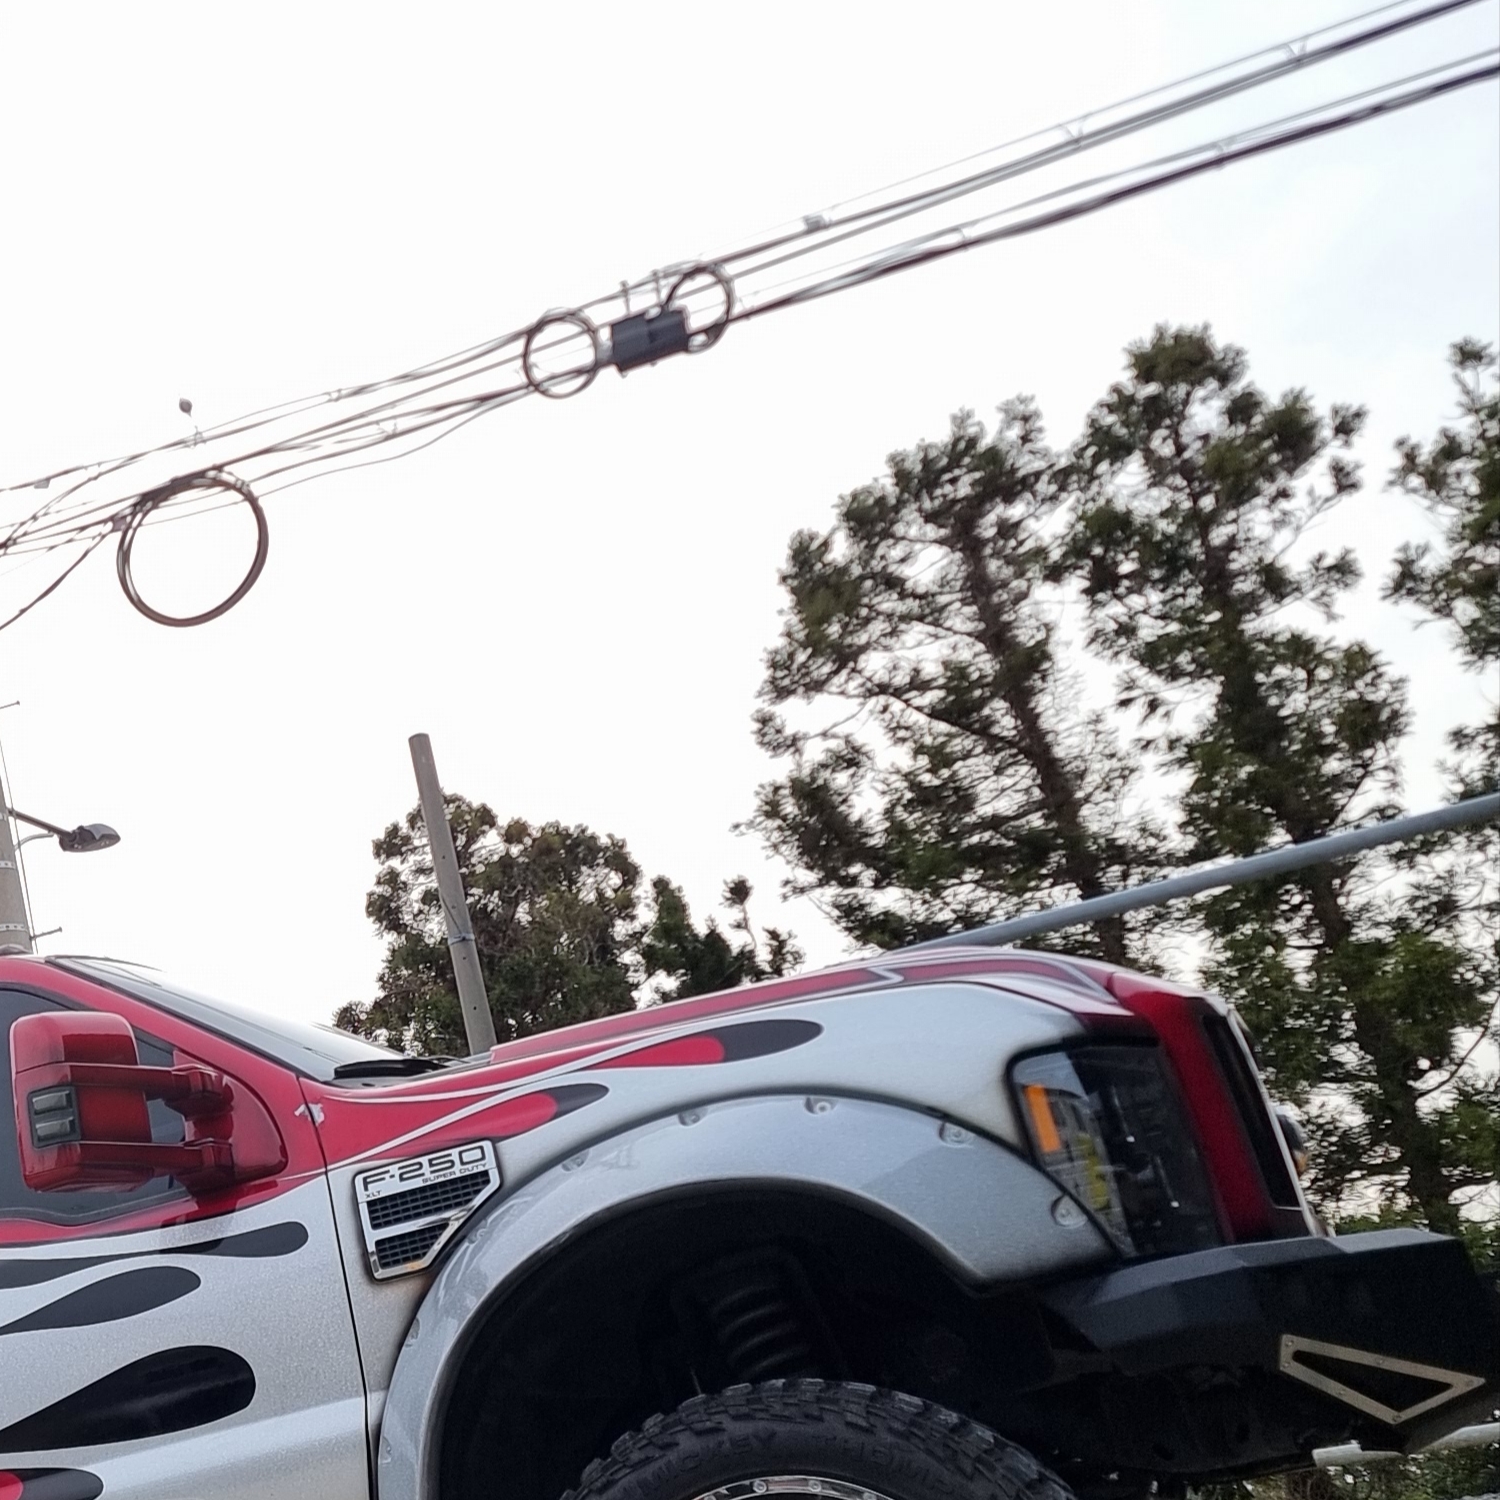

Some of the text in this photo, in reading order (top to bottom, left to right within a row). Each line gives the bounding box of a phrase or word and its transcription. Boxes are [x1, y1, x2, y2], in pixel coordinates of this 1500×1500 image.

[362, 1144, 486, 1192] F-250
[422, 1163, 488, 1185] SUPER DUTY
[365, 1190, 382, 1199] XLT
